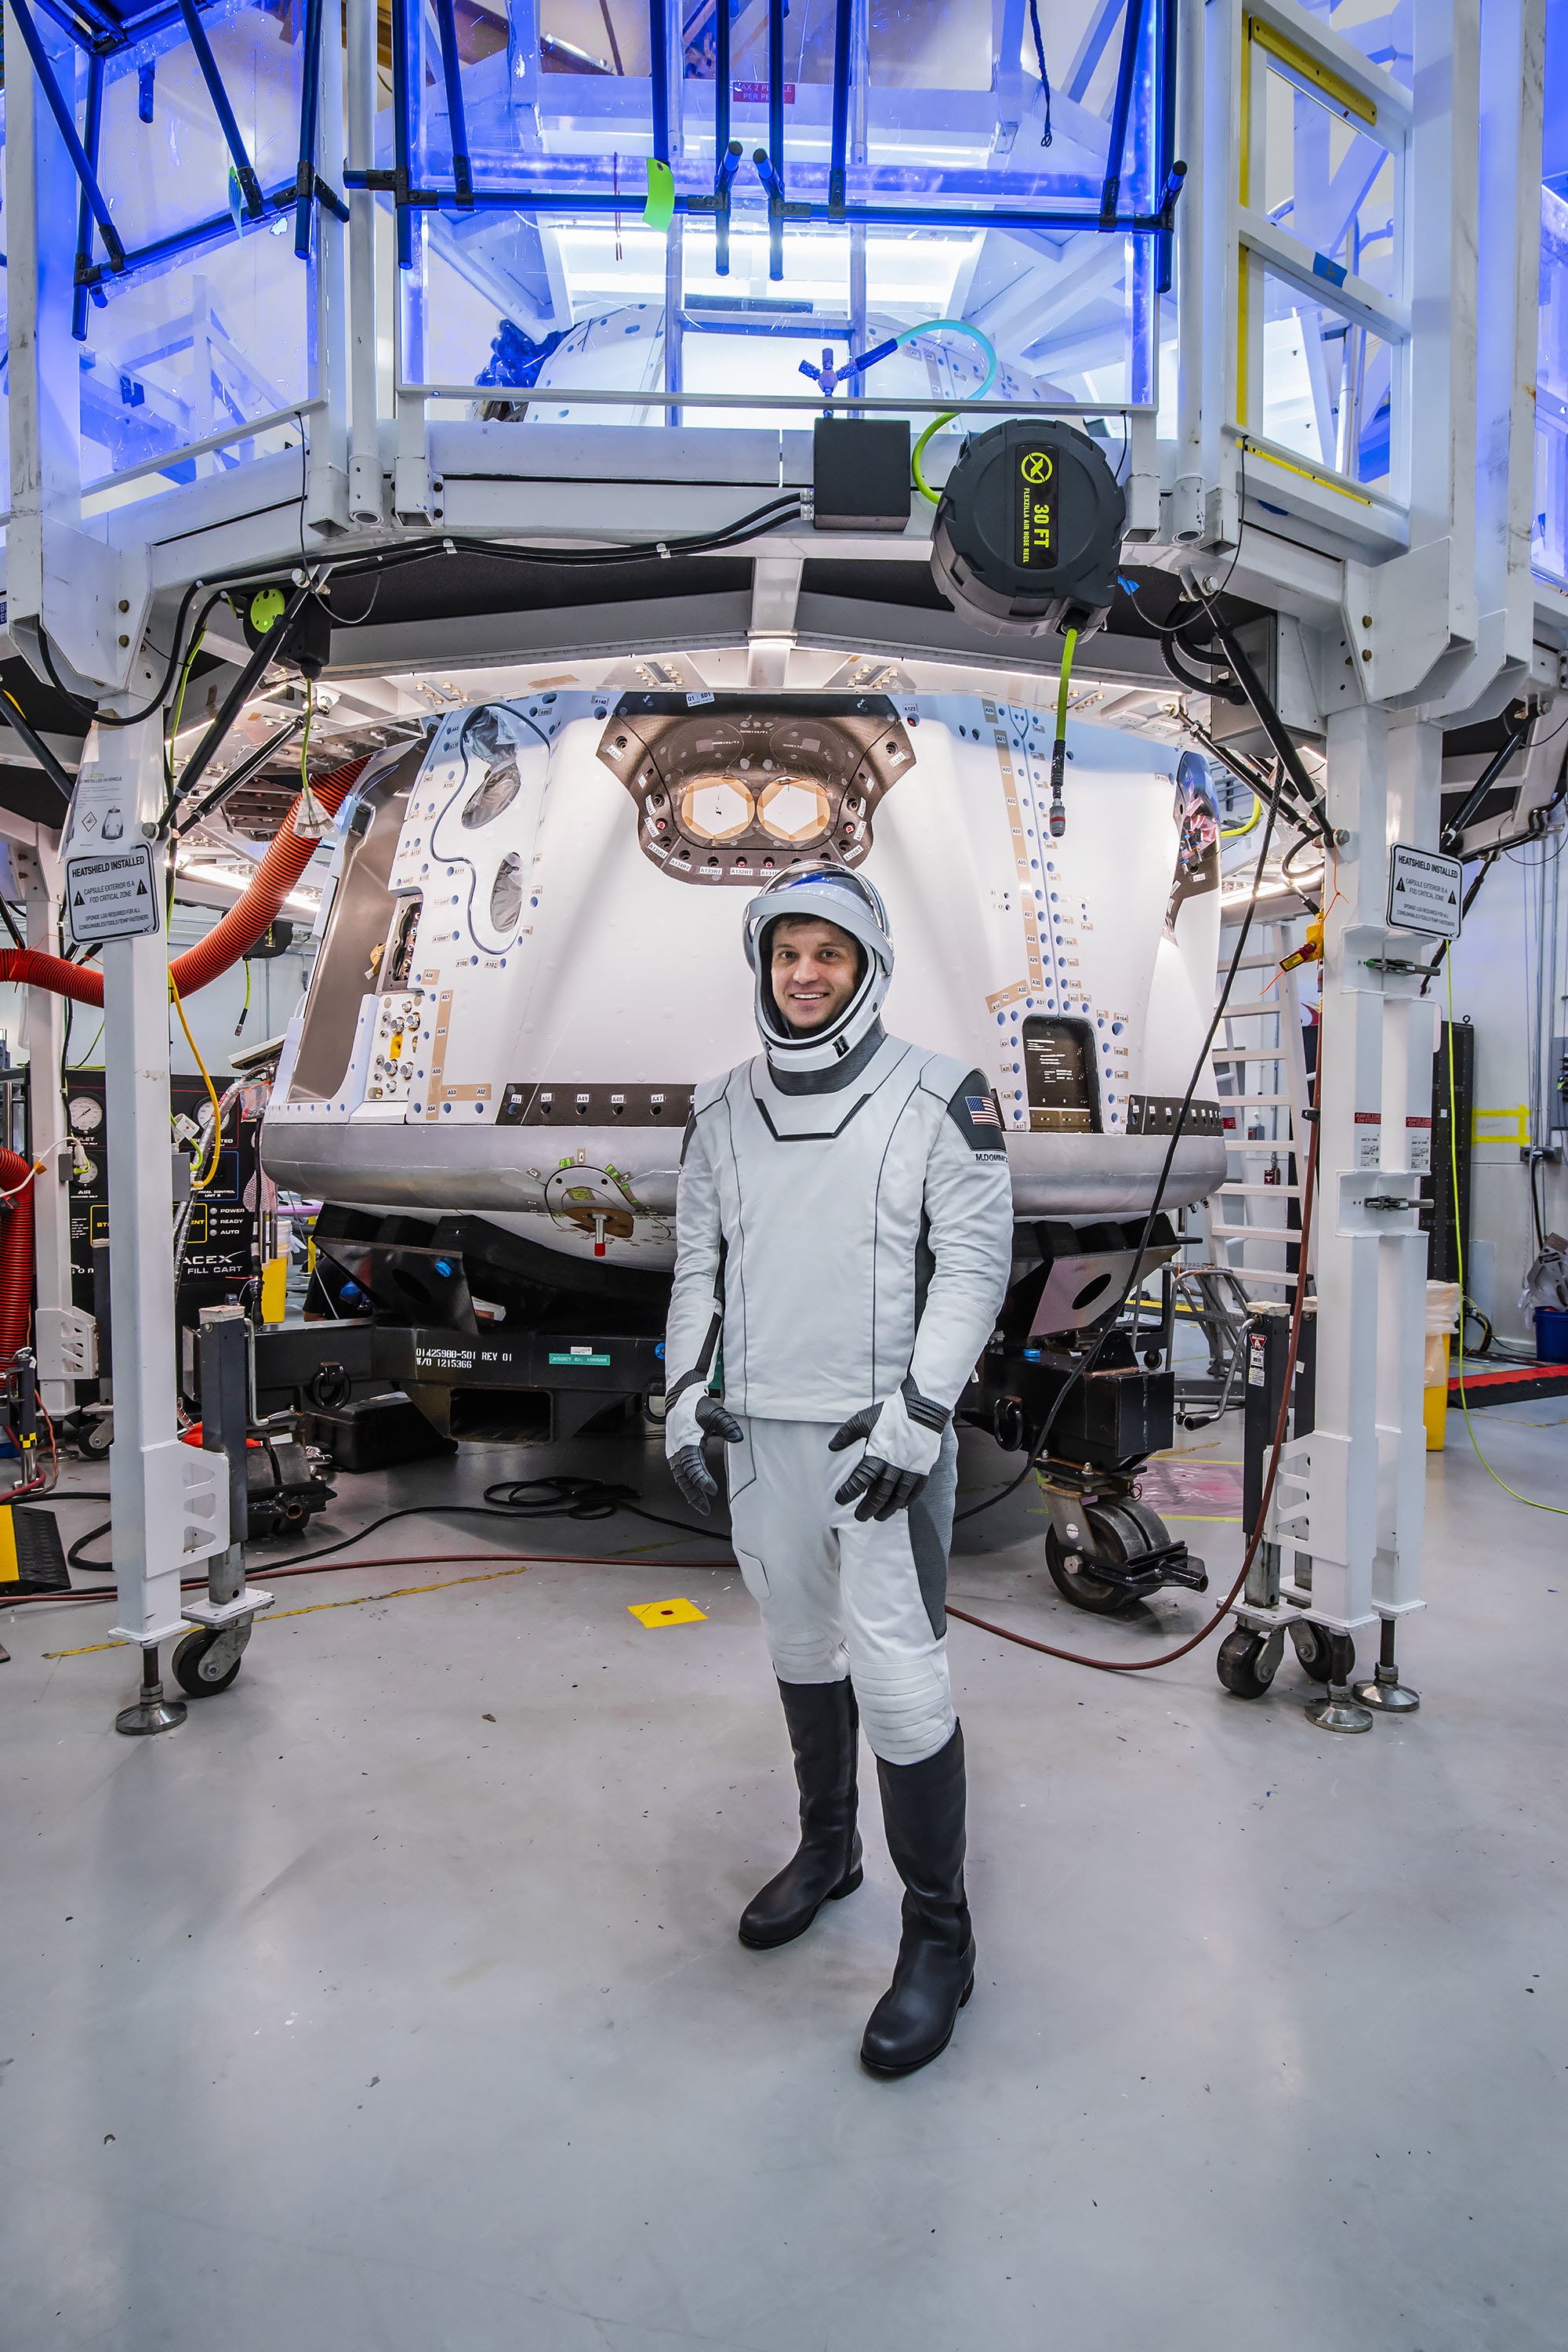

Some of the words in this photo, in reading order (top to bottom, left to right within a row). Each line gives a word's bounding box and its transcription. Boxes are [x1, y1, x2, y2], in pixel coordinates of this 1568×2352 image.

[1034, 504, 1050, 524] 30
[1034, 528, 1050, 548] FT
[72, 862, 110, 878] HEATSHIELD
[111, 855, 145, 870] INSTALLED
[670, 859, 690, 871] A134RT
[1399, 855, 1431, 871] HEATSHIELD
[1432, 865, 1458, 879] INSTALLED
[84, 886, 104, 895] CAPSULE
[105, 882, 126, 892] EXTERIOR
[1406, 878, 1423, 887] CAPSULE
[1424, 882, 1441, 891] EXTERIOR
[100, 892, 119, 902] CRITICAL
[120, 890, 132, 898] ZONE
[1418, 889, 1435, 899] CRITICAL
[1435, 893, 1444, 902] ZONE
[86, 913, 100, 922] SPONGE
[108, 909, 126, 918] REQUIRED
[482, 1352, 498, 1361] REV
[503, 1352, 512, 1362] 01
[437, 1359, 472, 1369] 1215366
